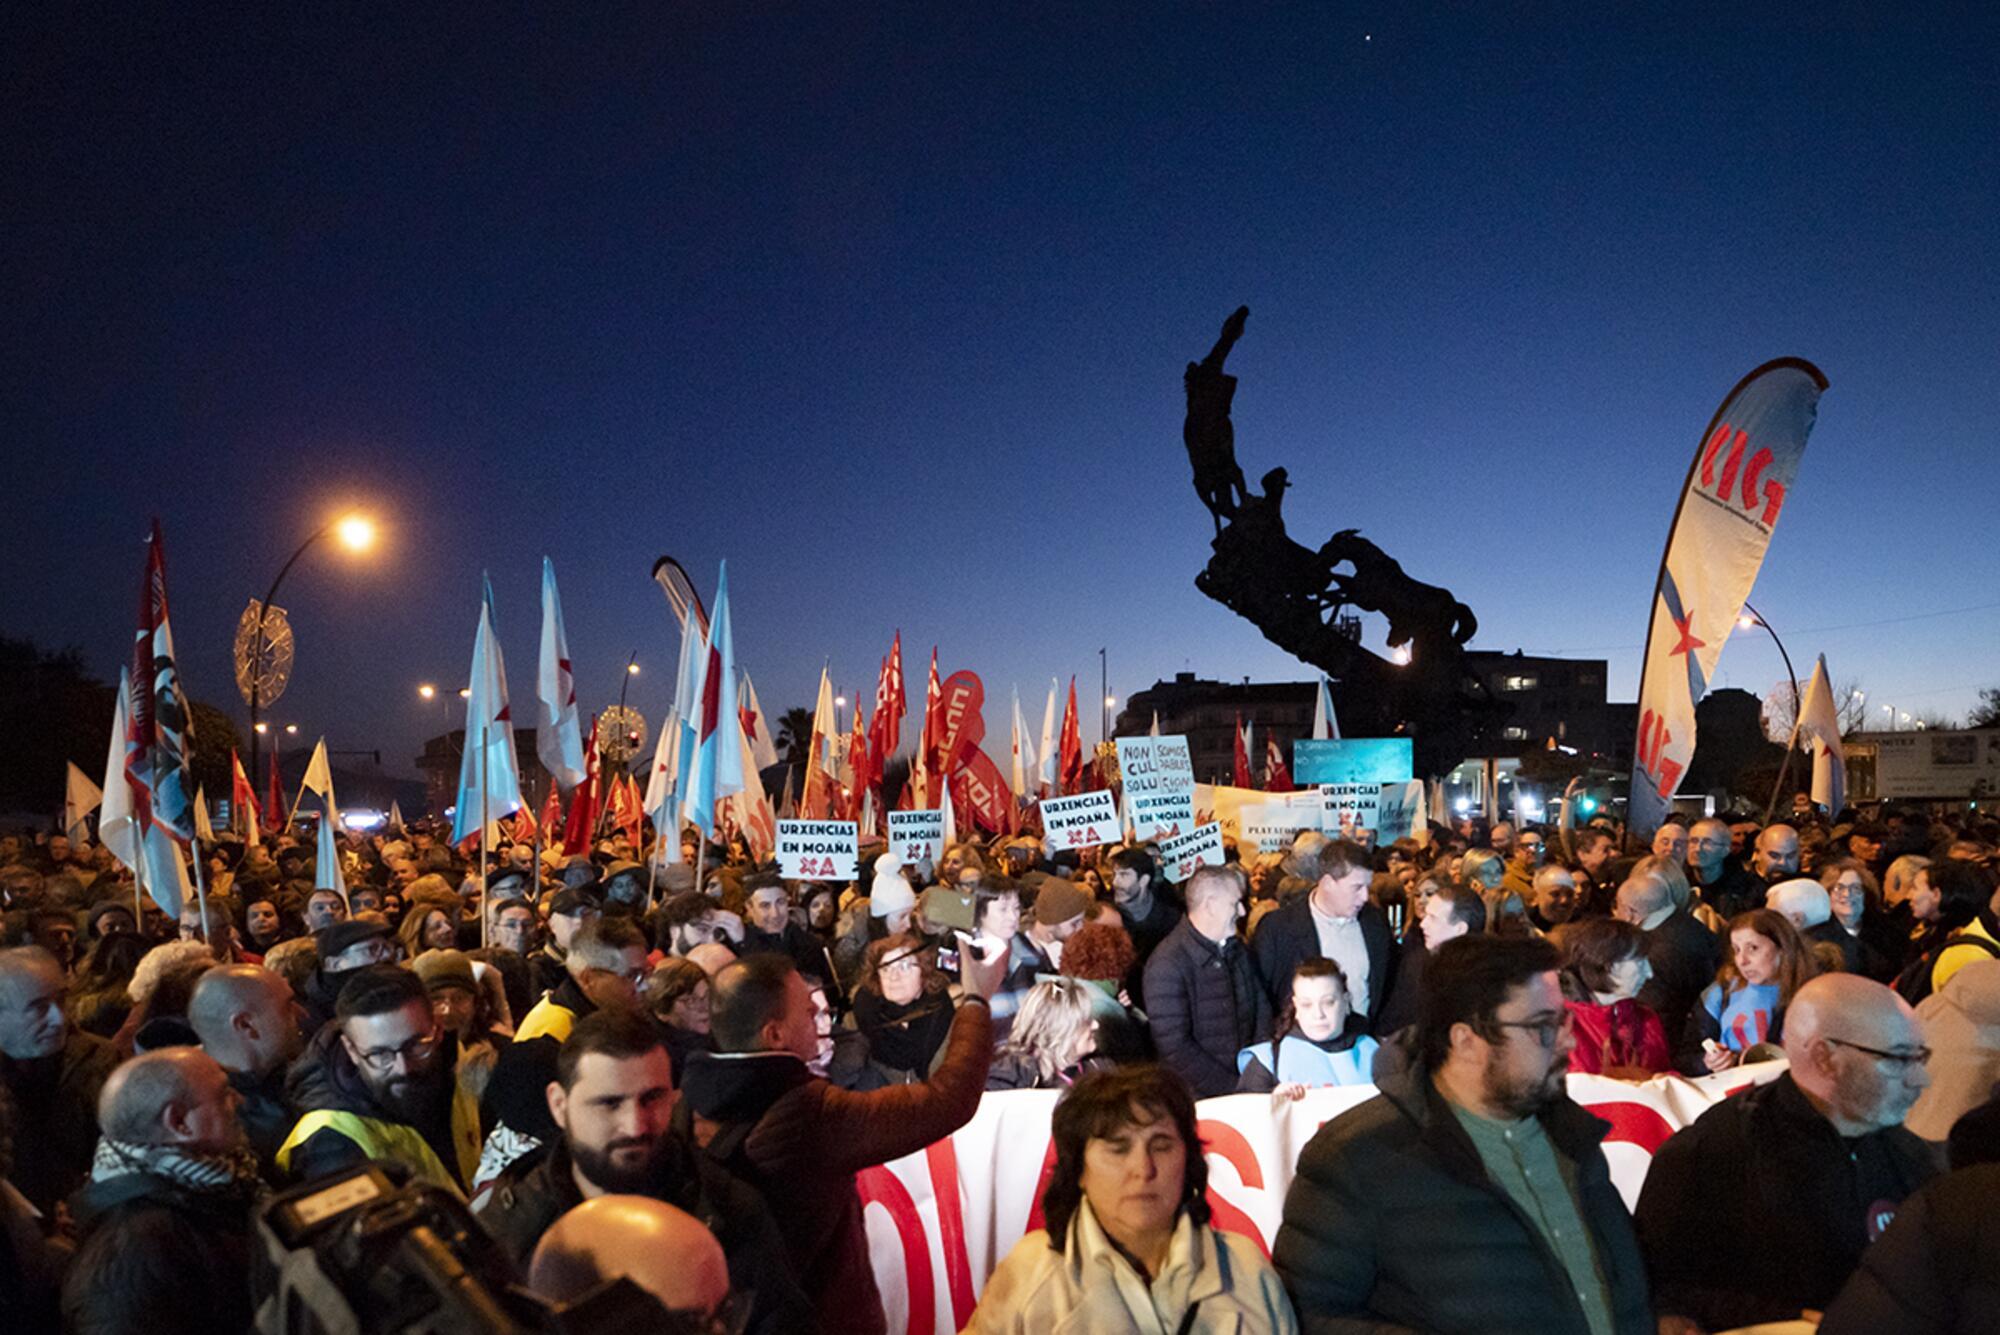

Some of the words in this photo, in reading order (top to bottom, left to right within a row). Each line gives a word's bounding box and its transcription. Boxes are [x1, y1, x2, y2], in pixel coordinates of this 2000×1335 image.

[1124, 746, 1150, 760] NON
[1322, 786, 1379, 796] URXENCIAS
[1044, 794, 1110, 814] URXENCIAS
[1136, 795, 1191, 809] URXENCIAS
[1325, 801, 1337, 810] EN
[891, 813, 943, 825] URXENCIAS
[1049, 819, 1064, 830] EN
[1066, 811, 1112, 828] MOAÑA
[1139, 812, 1153, 823] EN
[780, 824, 854, 836] URXENCIAS
[893, 830, 906, 841] EN
[1160, 825, 1218, 853] URXENCIAS
[782, 842, 799, 853] EN
[802, 840, 853, 854] MOAÑA
[1178, 839, 1218, 861] MOAÑA
